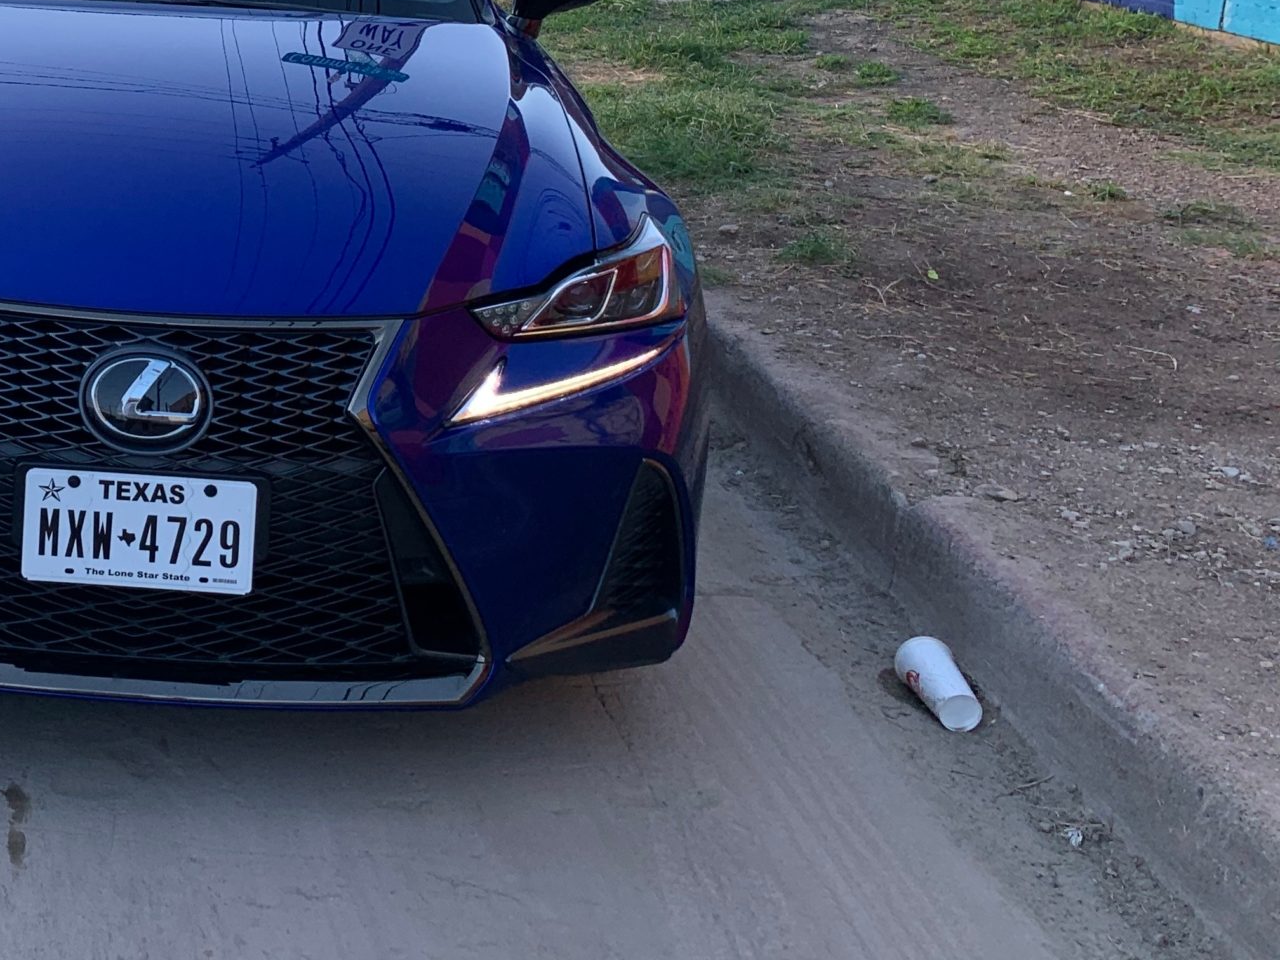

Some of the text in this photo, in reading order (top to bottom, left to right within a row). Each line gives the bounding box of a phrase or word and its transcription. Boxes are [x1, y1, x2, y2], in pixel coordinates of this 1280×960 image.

[98, 479, 185, 505] TEXAS
[85, 568, 190, 582] The Lone Star State
